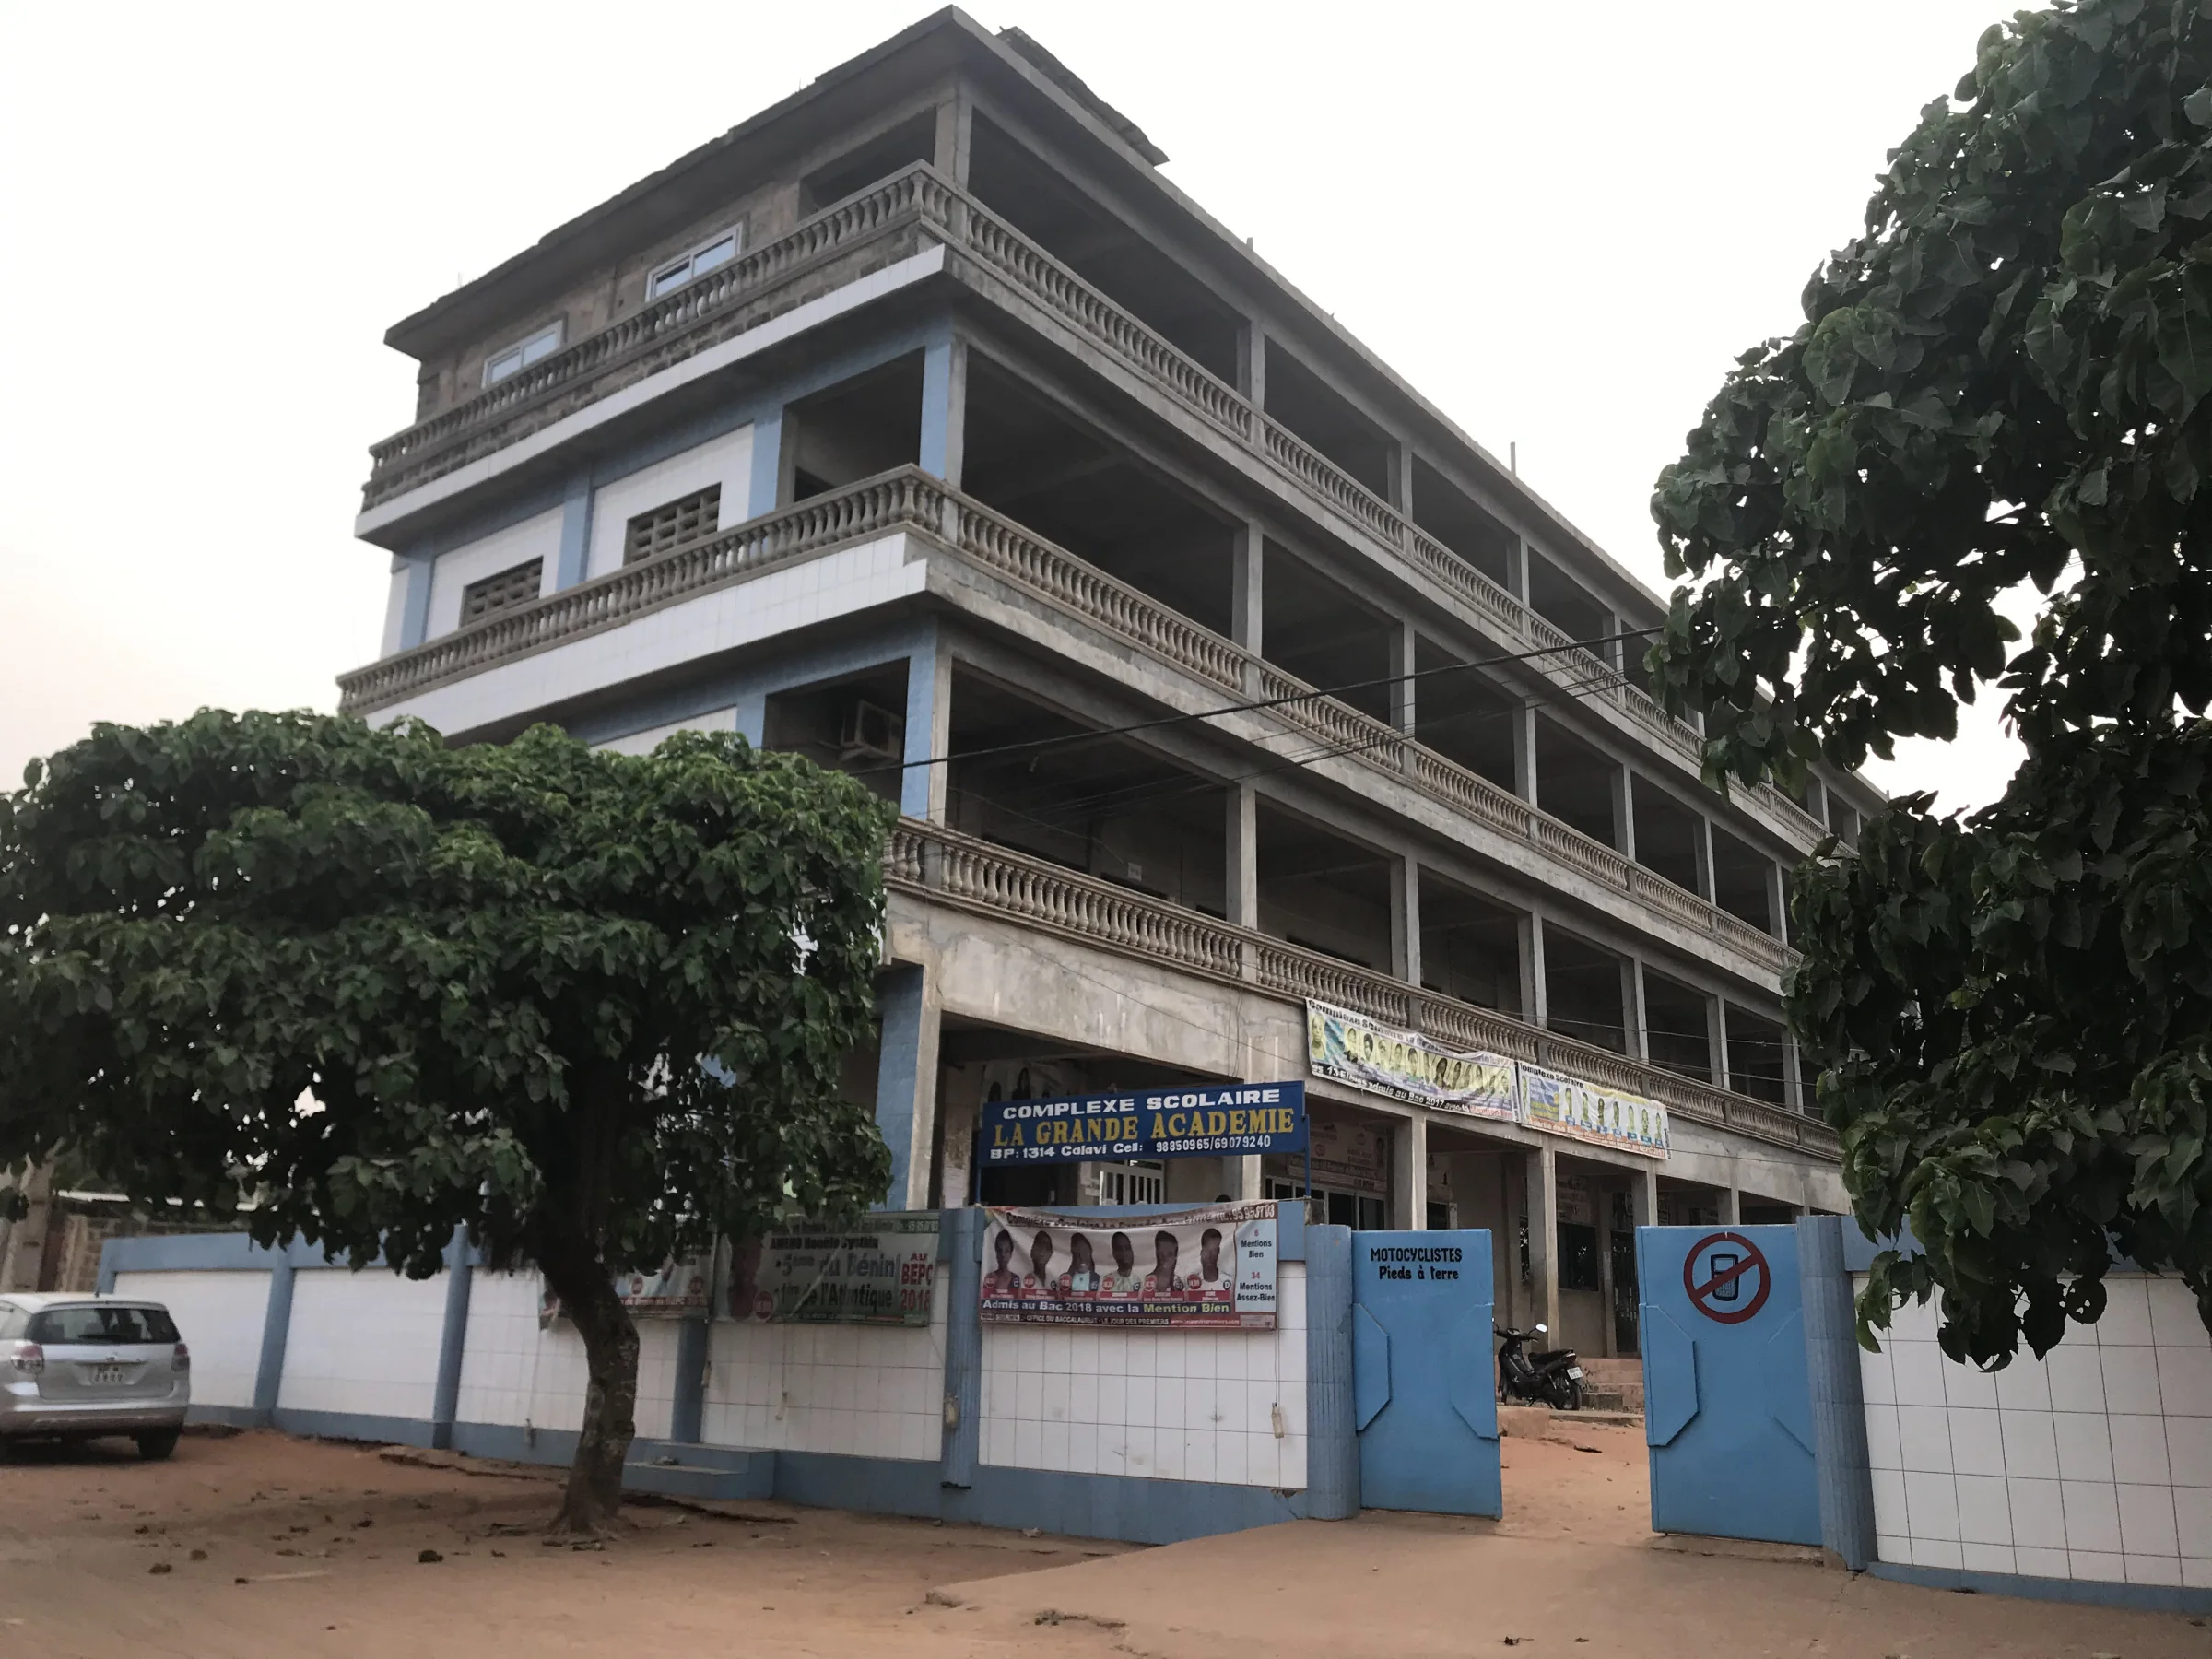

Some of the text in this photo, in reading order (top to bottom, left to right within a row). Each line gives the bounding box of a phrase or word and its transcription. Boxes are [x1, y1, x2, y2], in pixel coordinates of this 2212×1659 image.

[1003, 1088, 1280, 1120] COMPLEXE SCOLAIRE
[1394, 1088, 1407, 1099] au
[1407, 1092, 1424, 1104] Bac
[1425, 1096, 1445, 1108] 2017
[993, 1122, 1025, 1147] LA
[1035, 1115, 1139, 1145] GRANDE
[1149, 1108, 1294, 1139] ACADEMIE
[1022, 1146, 1055, 1159] 1314
[1061, 1144, 1107, 1157] Calavi
[1113, 1142, 1143, 1153] Cell:
[1241, 1240, 1272, 1248] Mentions
[910, 1253, 927, 1261] AU
[1248, 1249, 1264, 1258] Bien
[1371, 1247, 1463, 1262] MOTOCYCLISTES
[901, 1264, 933, 1285] BEPC
[1251, 1271, 1261, 1279] 34
[1379, 1265, 1412, 1279] Pieds
[1418, 1265, 1425, 1279] à
[1240, 1282, 1273, 1291] Mentions
[900, 1289, 931, 1311] 2018
[1236, 1293, 1275, 1301] Assez-Bien
[982, 1300, 1019, 1309] Admis
[1040, 1301, 1063, 1311] Bac
[1065, 1302, 1092, 1312] 2018
[1096, 1304, 1125, 1312] avec
[1128, 1303, 1139, 1312] la
[1143, 1303, 1197, 1312] Mention
[1202, 1303, 1230, 1312] Bien
